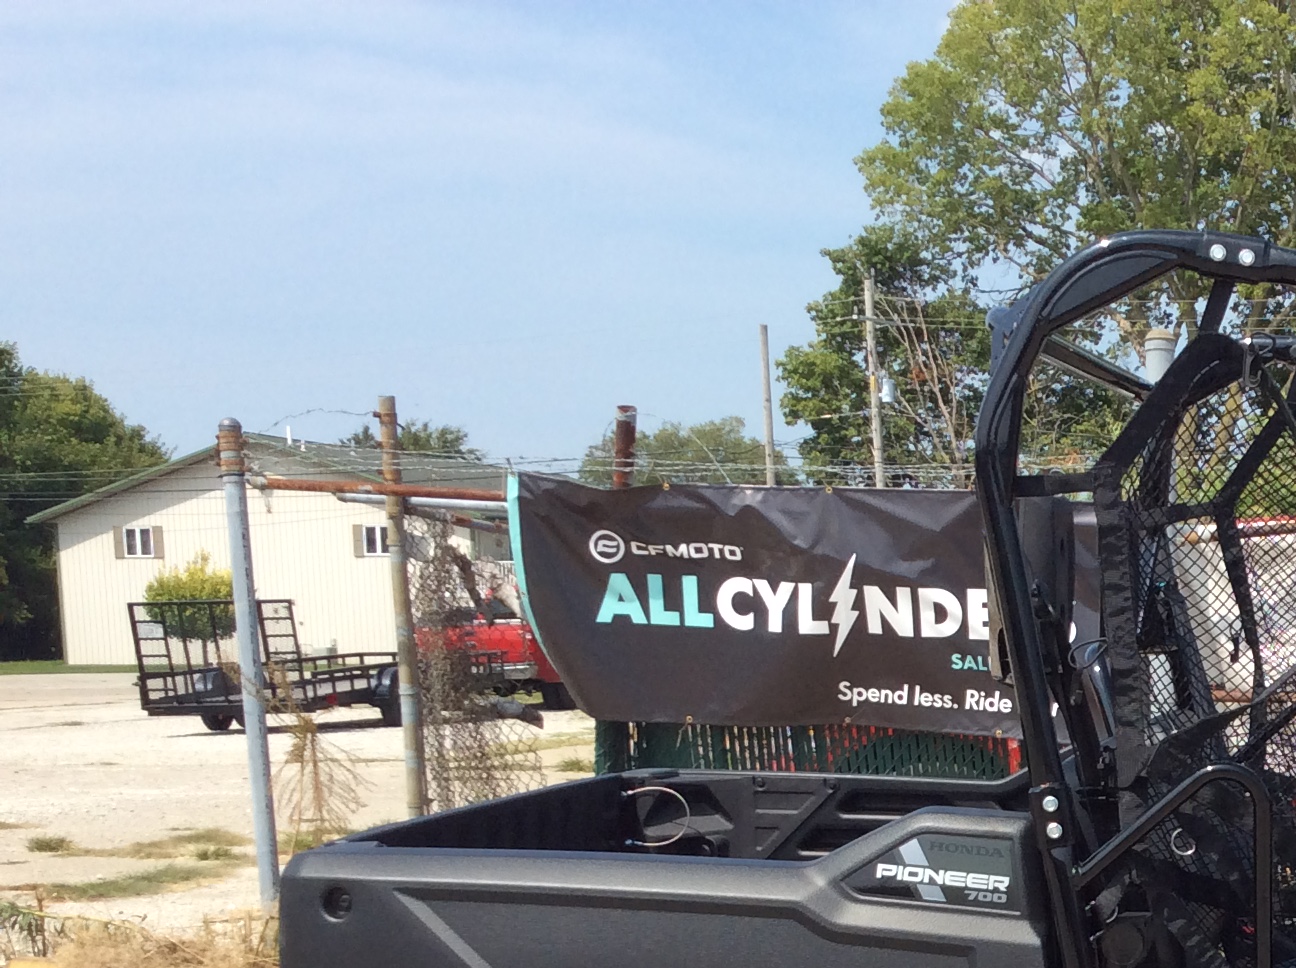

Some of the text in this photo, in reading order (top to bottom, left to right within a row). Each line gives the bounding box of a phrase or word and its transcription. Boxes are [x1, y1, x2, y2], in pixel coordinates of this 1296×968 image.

[629, 541, 743, 561] CFMOTO
[951, 653, 992, 672] SAL
[837, 681, 1013, 713] Spend less. Ride
[928, 841, 1006, 858] HONDA
[875, 863, 1010, 891] PIONEER
[963, 890, 1008, 903] 700
